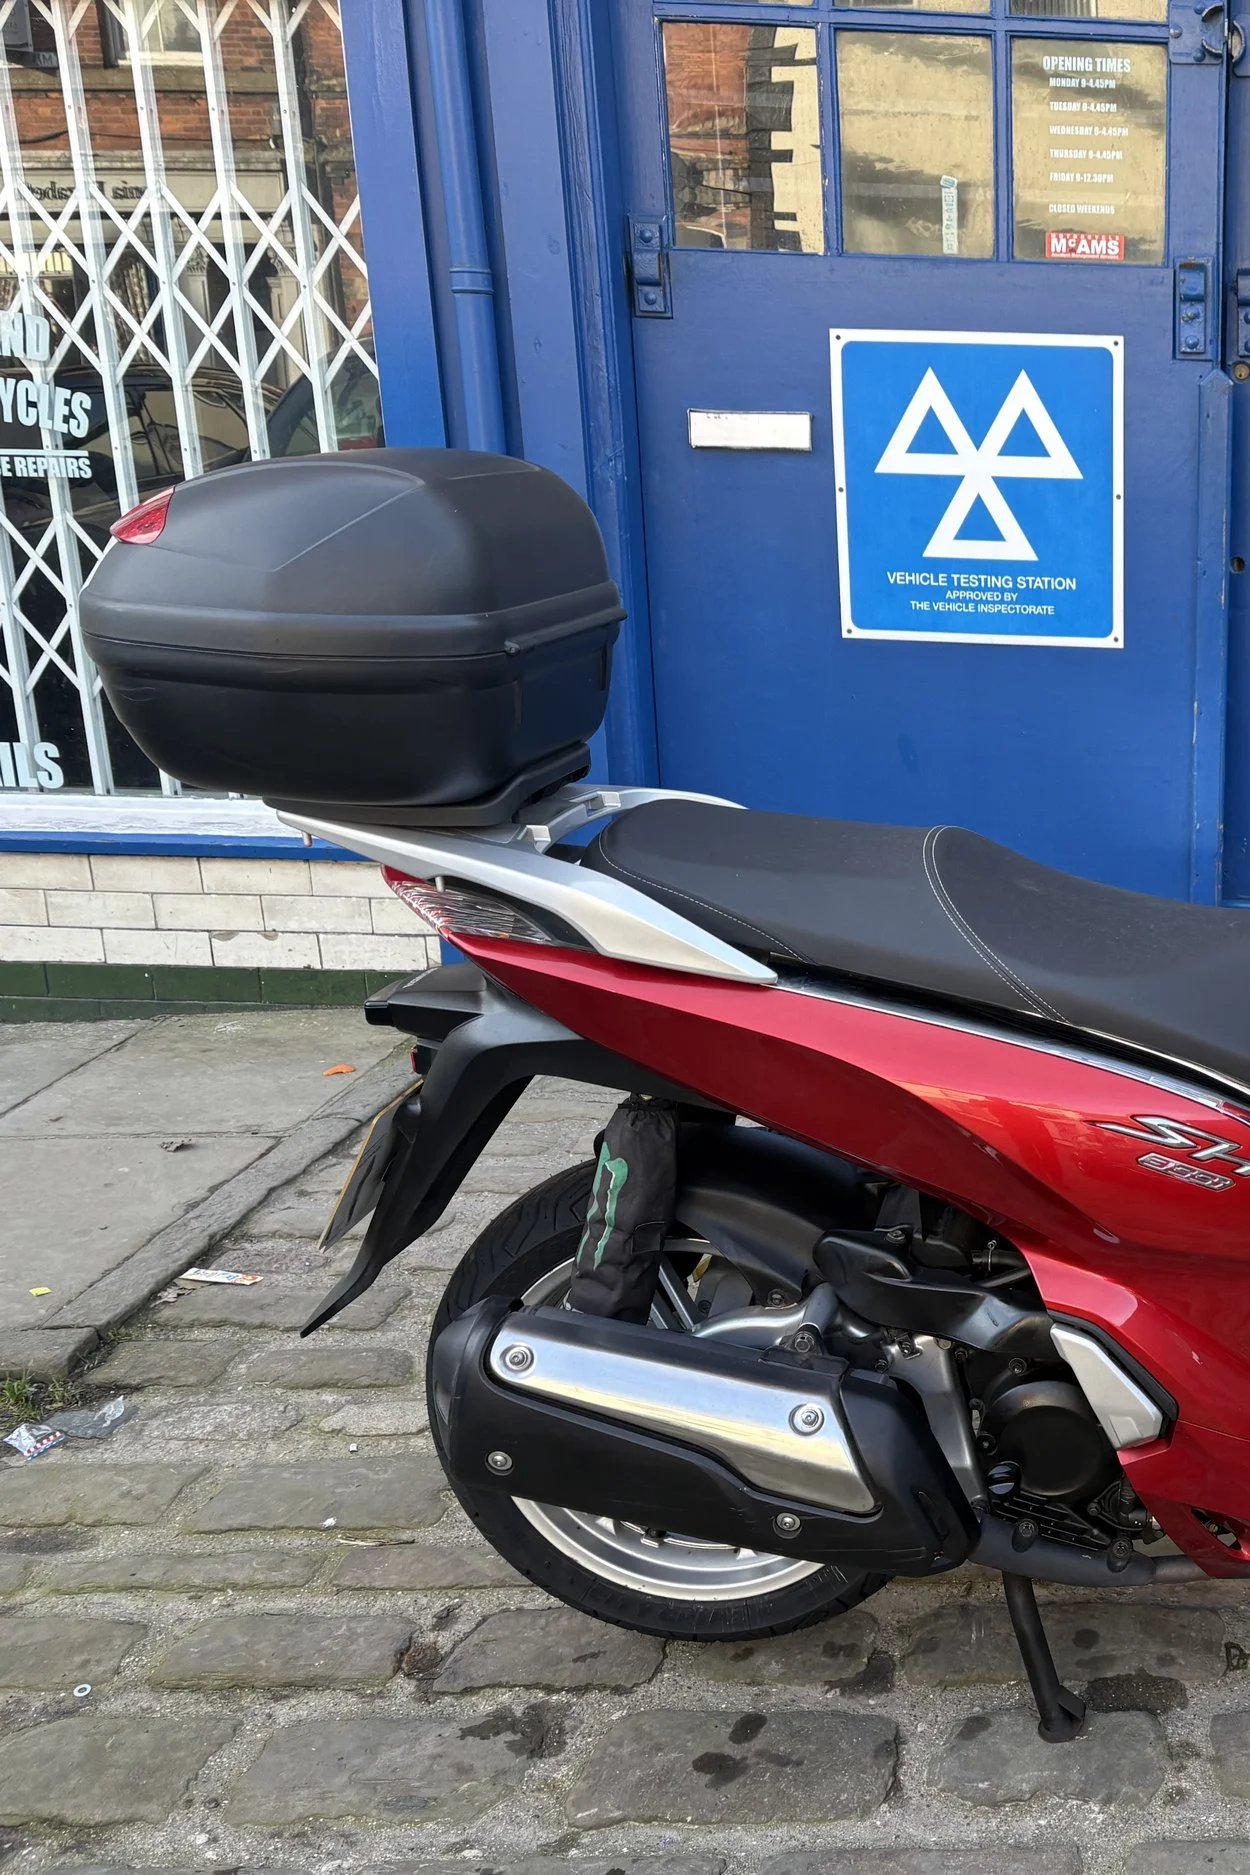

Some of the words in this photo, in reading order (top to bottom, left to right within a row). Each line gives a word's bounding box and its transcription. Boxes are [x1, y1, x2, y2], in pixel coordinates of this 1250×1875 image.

[1042, 55, 1093, 72] OPENING
[1094, 57, 1131, 73] TIMES
[1049, 77, 1080, 87] MONDAY
[1081, 78, 1116, 89] 9-4.45PM
[1049, 101, 1081, 111] TUESDAY
[1049, 125, 1093, 136] WEDNESDAY
[1049, 148, 1087, 159] THURSDAY
[1049, 172, 1074, 182] FRIDAY
[1049, 203, 1076, 213] CLOSED
[1076, 204, 1115, 214] WEEKENDS
[0, 311, 50, 361] ND
[0, 456, 12, 477] E
[14, 456, 93, 479] REPAIRS
[887, 571, 948, 586] VEHICLE
[951, 574, 1013, 588] TESTING
[1017, 576, 1077, 590] STATION
[945, 590, 1002, 601] APPROVED
[1004, 592, 1018, 602] BY
[910, 600, 931, 611] THE
[932, 602, 976, 613] VEHICLE
[978, 604, 1055, 615] INSPECTORATE
[0, 742, 64, 789] ILS
